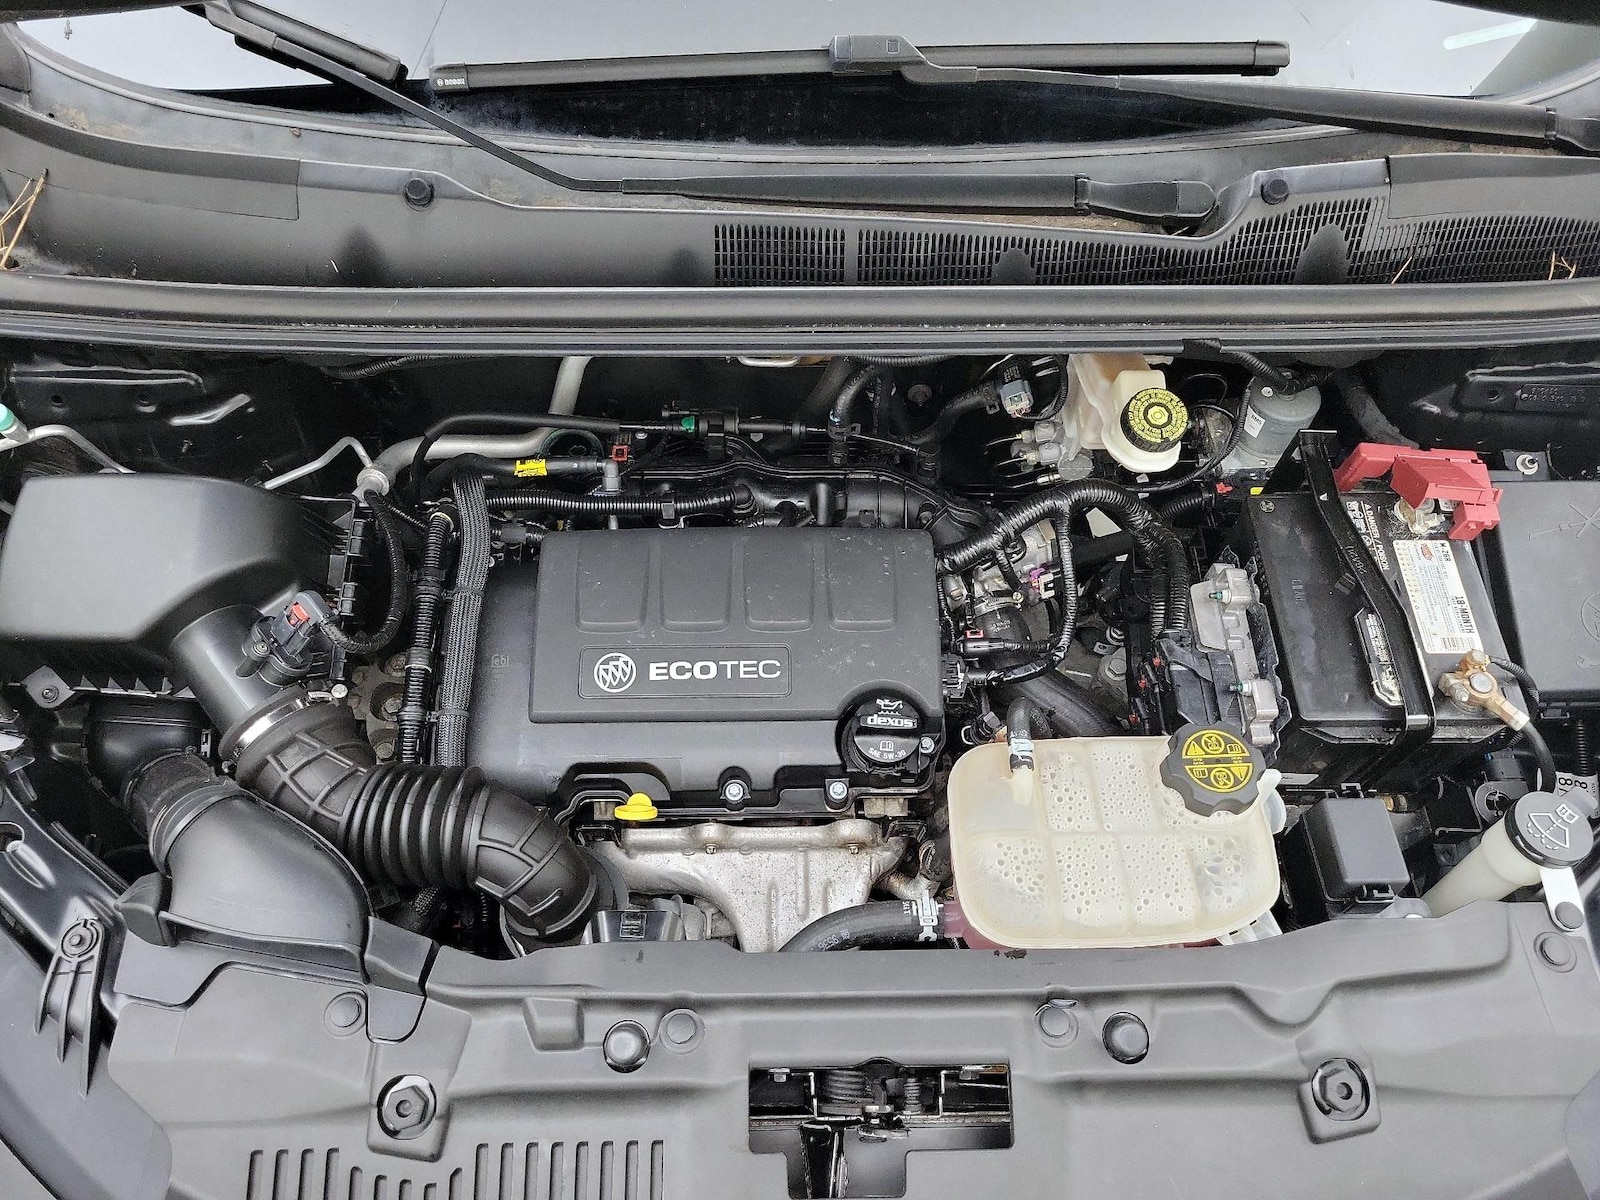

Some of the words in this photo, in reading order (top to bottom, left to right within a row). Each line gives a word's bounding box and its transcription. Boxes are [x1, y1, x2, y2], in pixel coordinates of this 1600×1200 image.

[1366, 510, 1381, 540] DANGER
[1375, 545, 1390, 571] POISON
[1455, 596, 1475, 634] 18-MONTH
[649, 659, 782, 681] ECOTEC
[867, 714, 913, 728] dexos
[868, 747, 881, 758] SAE
[883, 749, 907, 760] 5W-30
